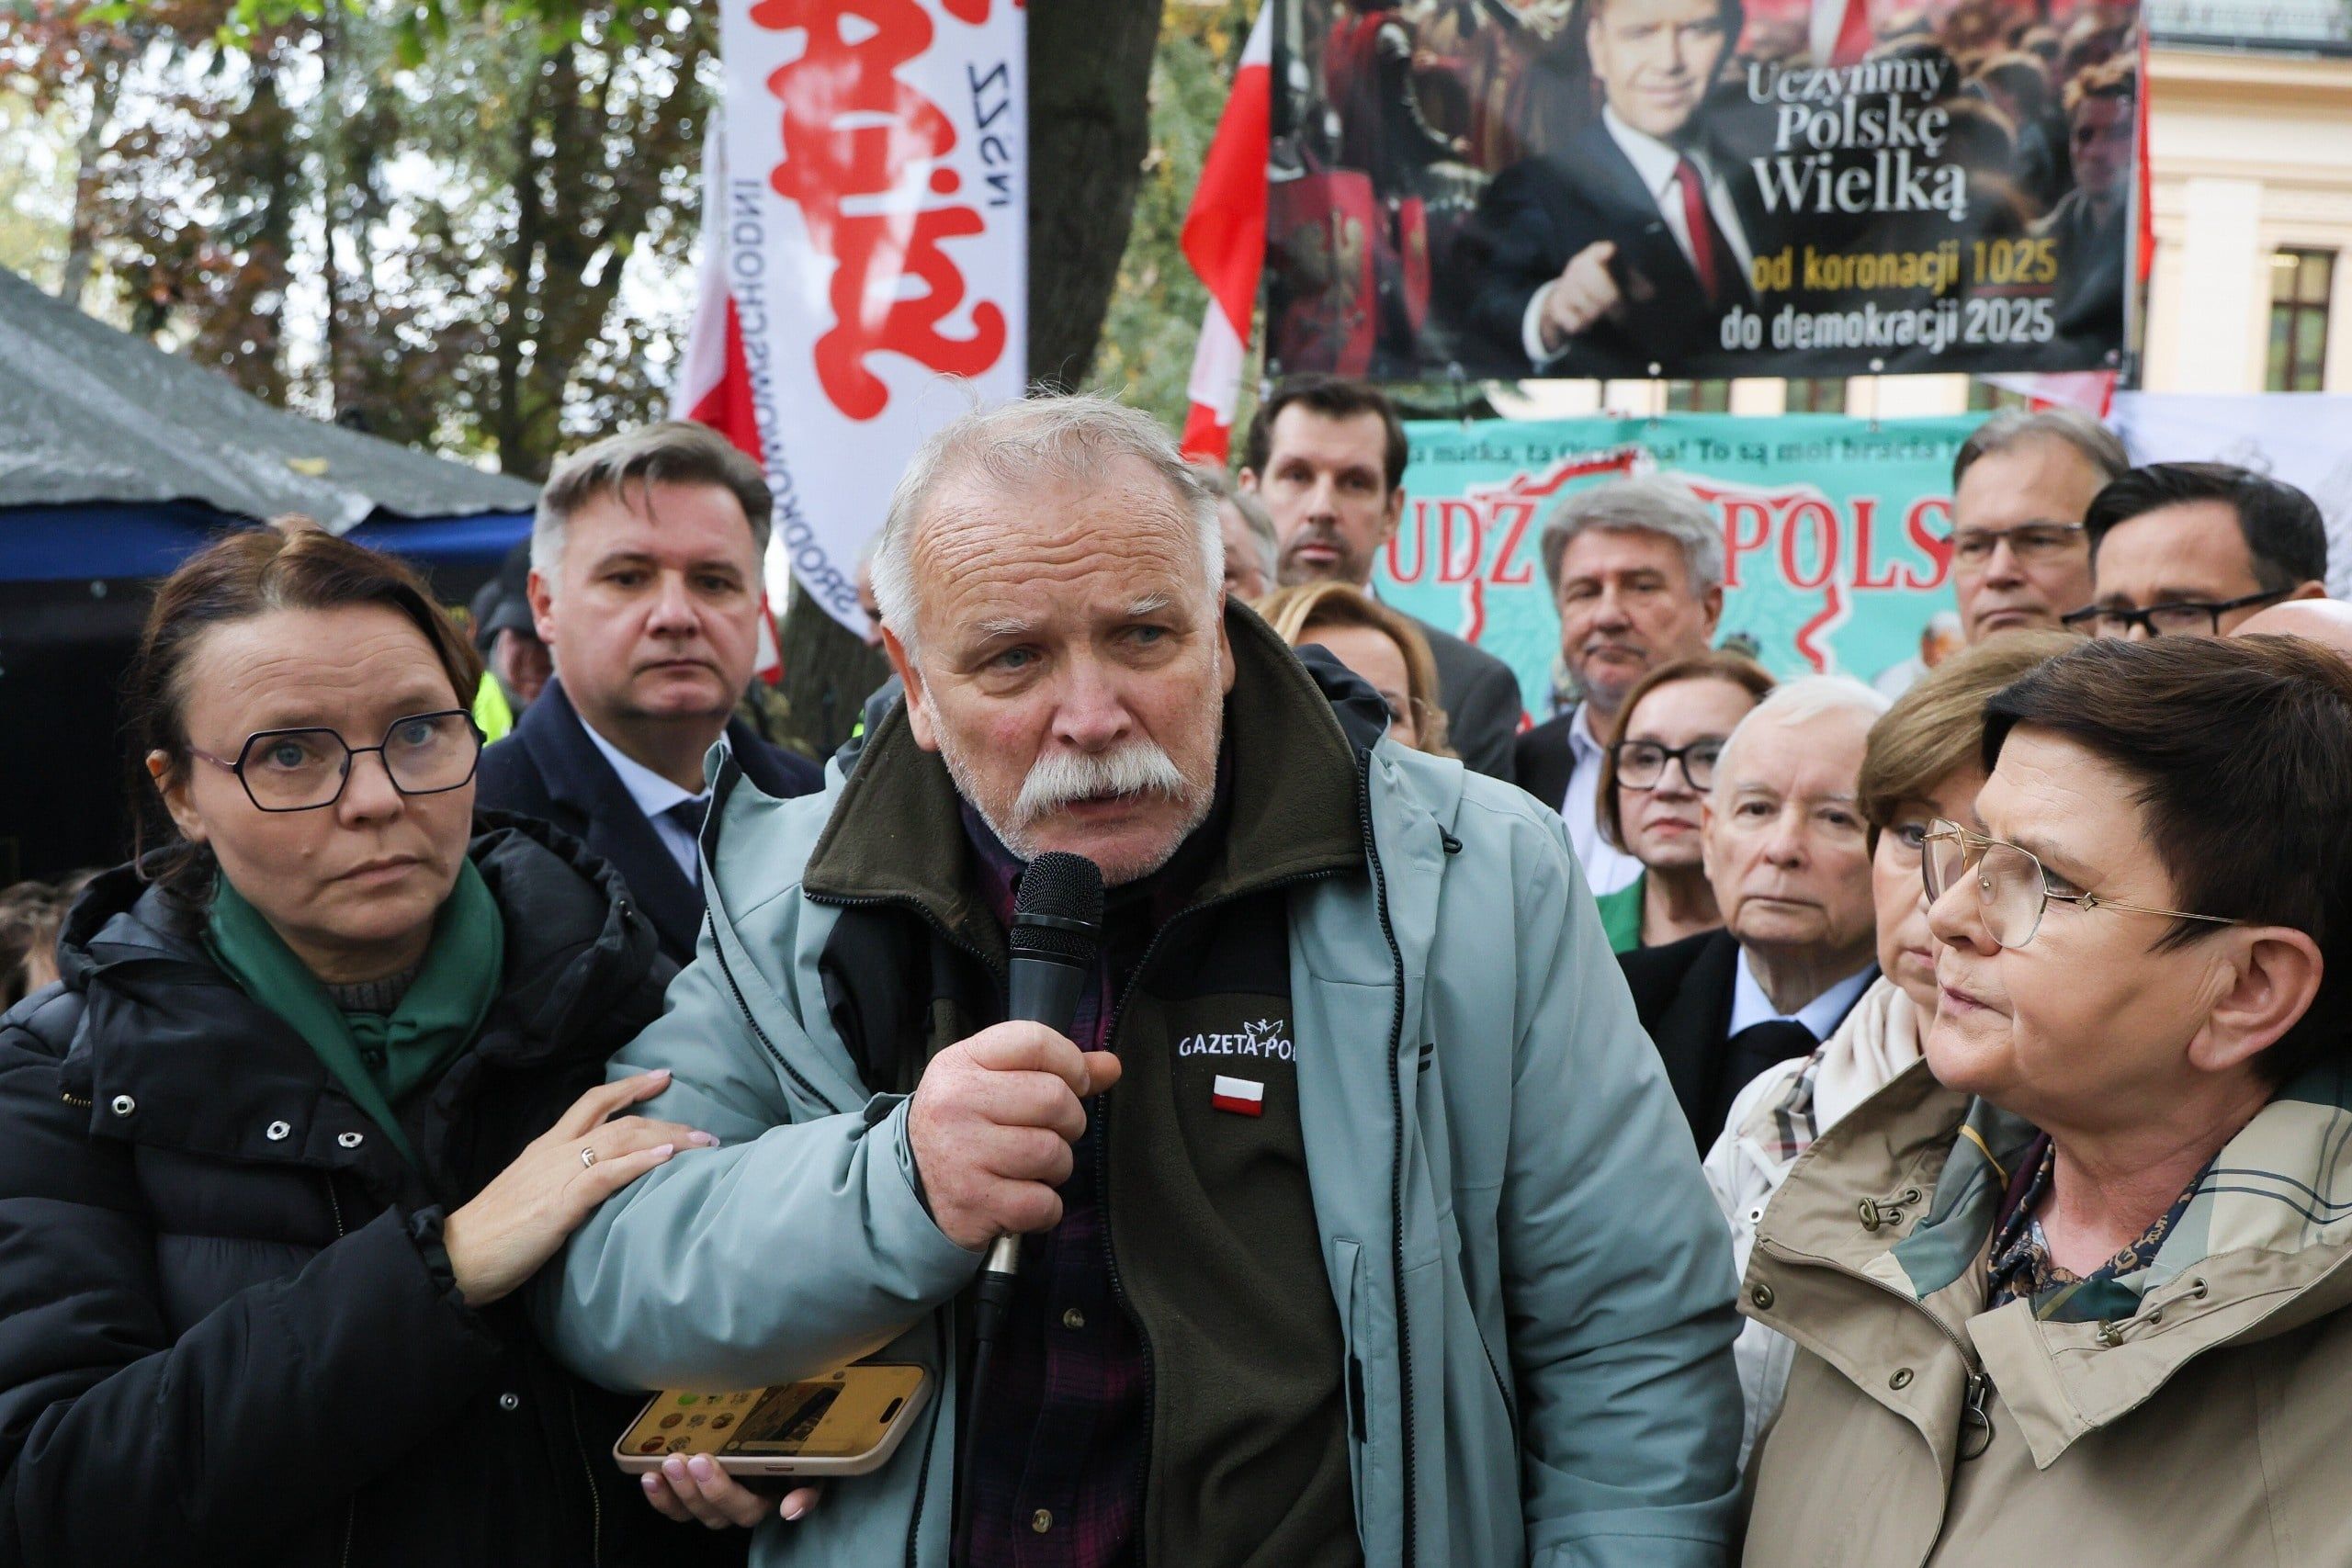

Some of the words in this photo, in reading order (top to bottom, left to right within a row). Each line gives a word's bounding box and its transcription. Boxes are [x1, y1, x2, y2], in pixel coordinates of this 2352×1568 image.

[1774, 93, 1950, 158] Polskę
[1751, 148, 1969, 221] Wielką
[1752, 244, 1793, 291] od
[1804, 238, 1960, 296] koronacji
[1973, 237, 2058, 285] 1025
[1720, 303, 1763, 351] do
[1771, 299, 1959, 355] demokracji
[1964, 298, 2056, 344] 2025
[1698, 438, 1730, 463] To
[1179, 1033, 1259, 1056] GAZETA
